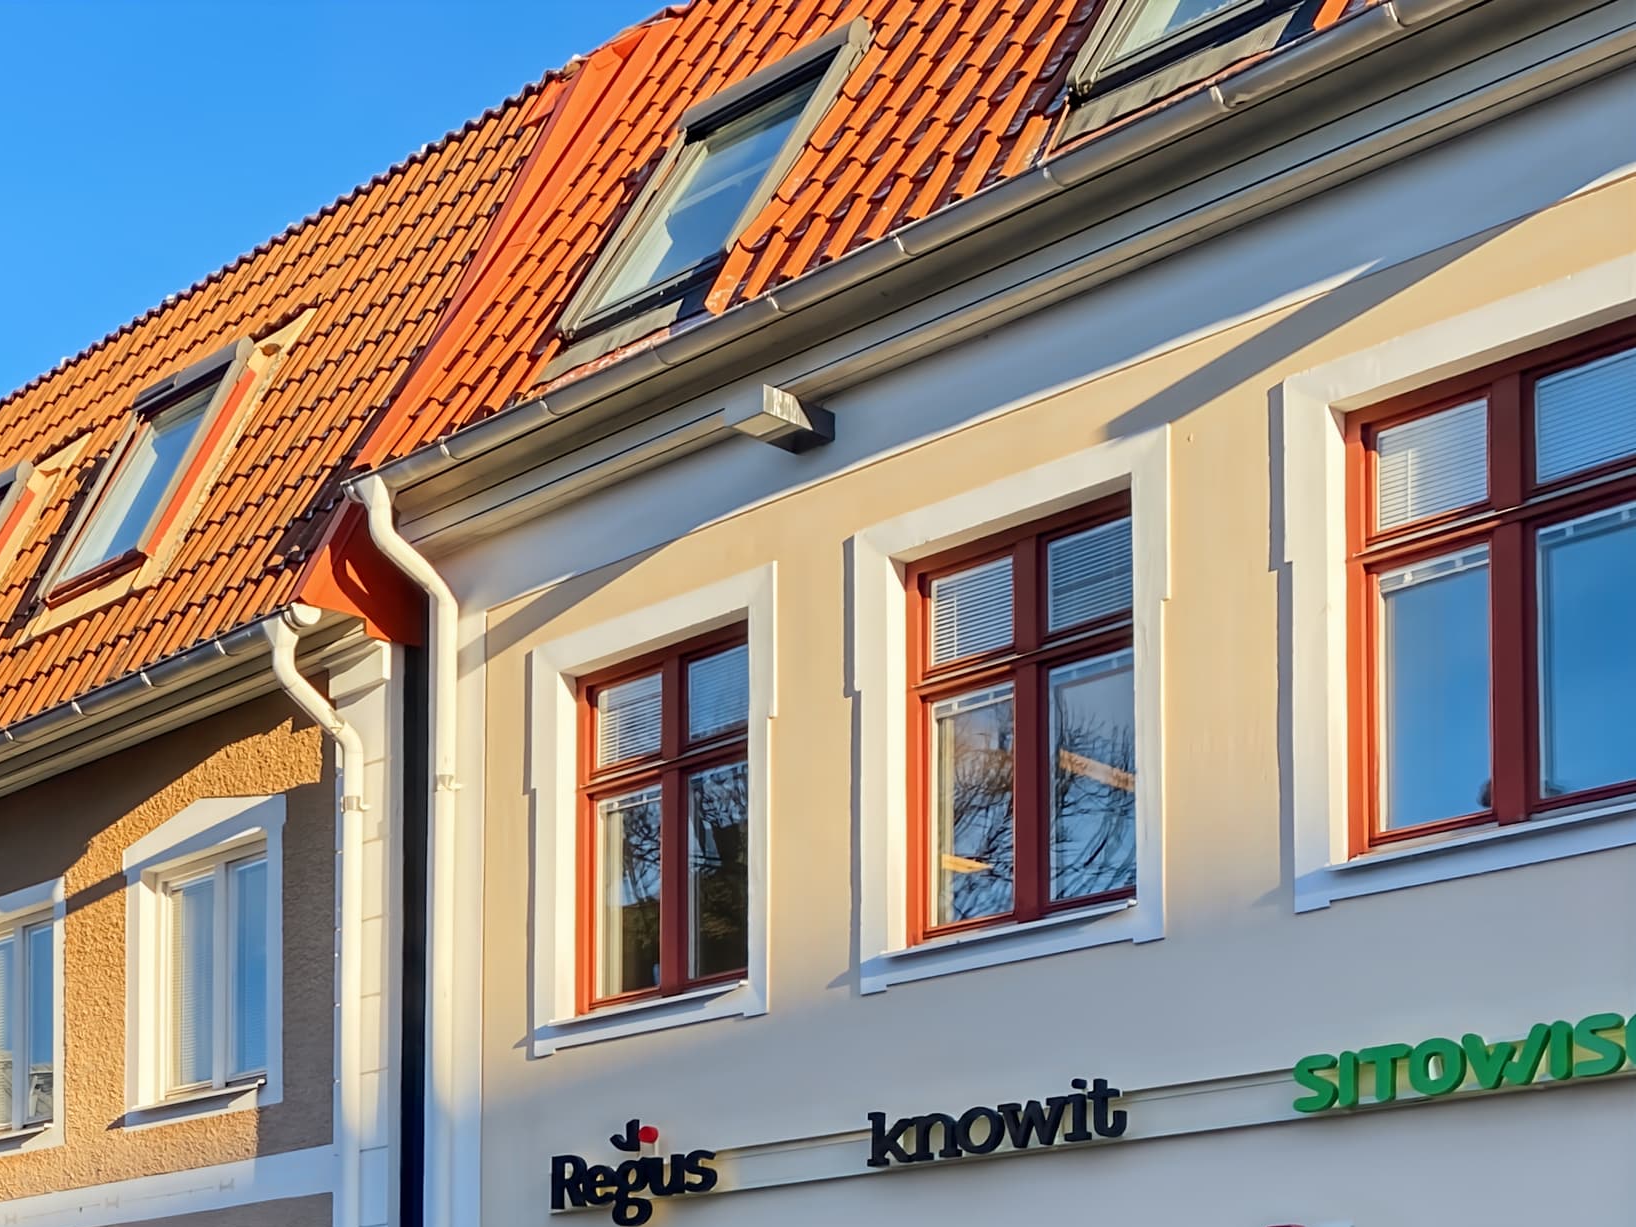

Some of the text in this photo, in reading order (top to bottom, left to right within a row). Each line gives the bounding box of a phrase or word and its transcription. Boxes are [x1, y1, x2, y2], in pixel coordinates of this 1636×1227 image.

[1292, 1013, 1636, 1113] SITOWIS
[867, 1078, 1127, 1167] knowit
[551, 1140, 718, 1227] Regus
